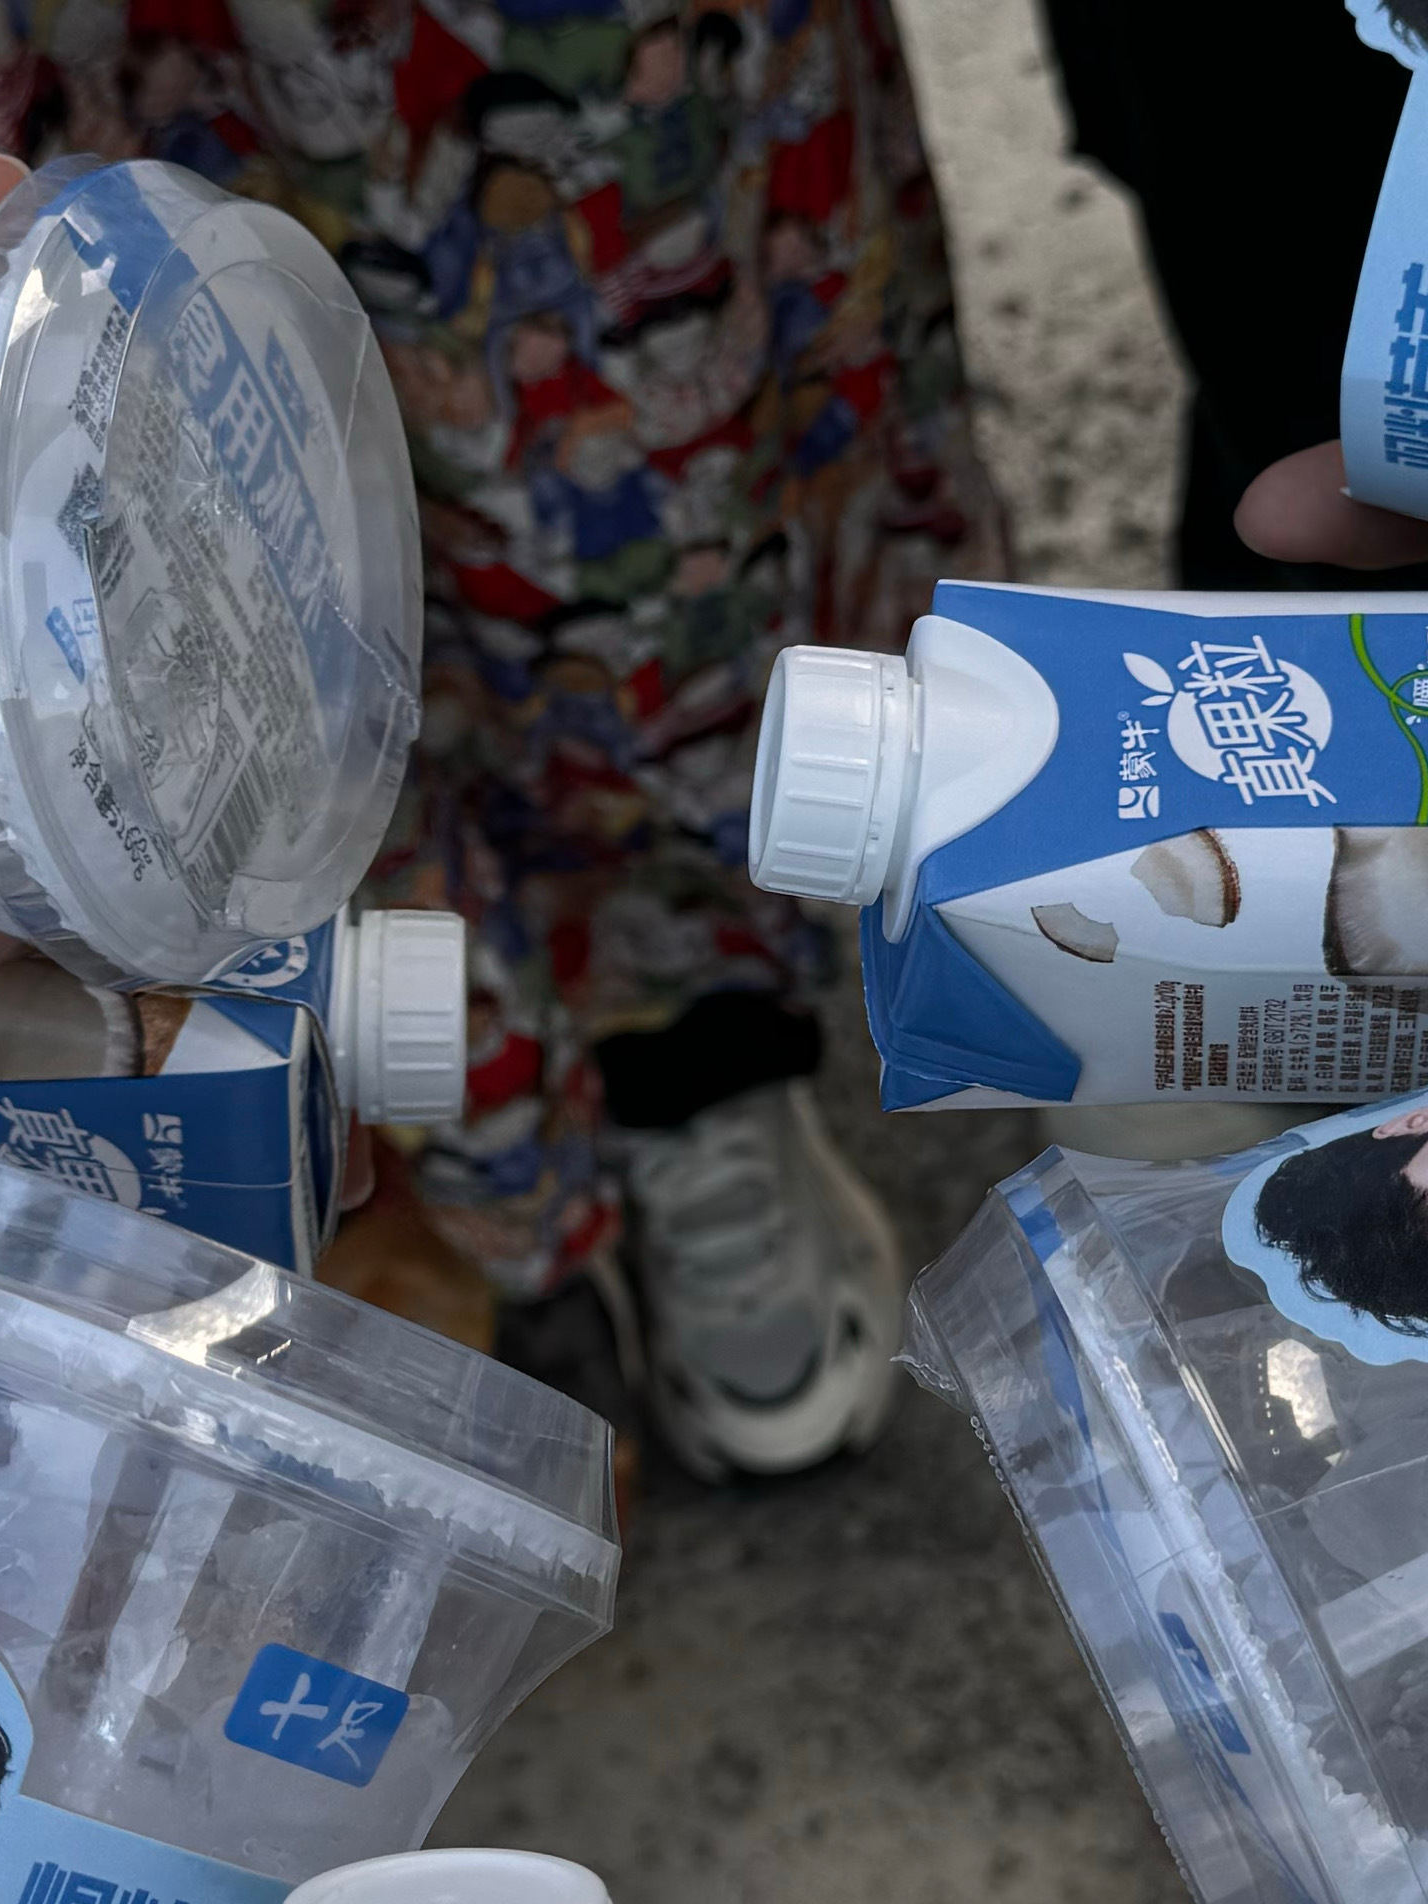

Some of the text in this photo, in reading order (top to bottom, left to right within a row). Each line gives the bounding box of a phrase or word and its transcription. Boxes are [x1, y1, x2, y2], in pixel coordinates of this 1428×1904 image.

[1177, 634, 1337, 807] 真果粒
[258, 1671, 385, 1770] 十足
